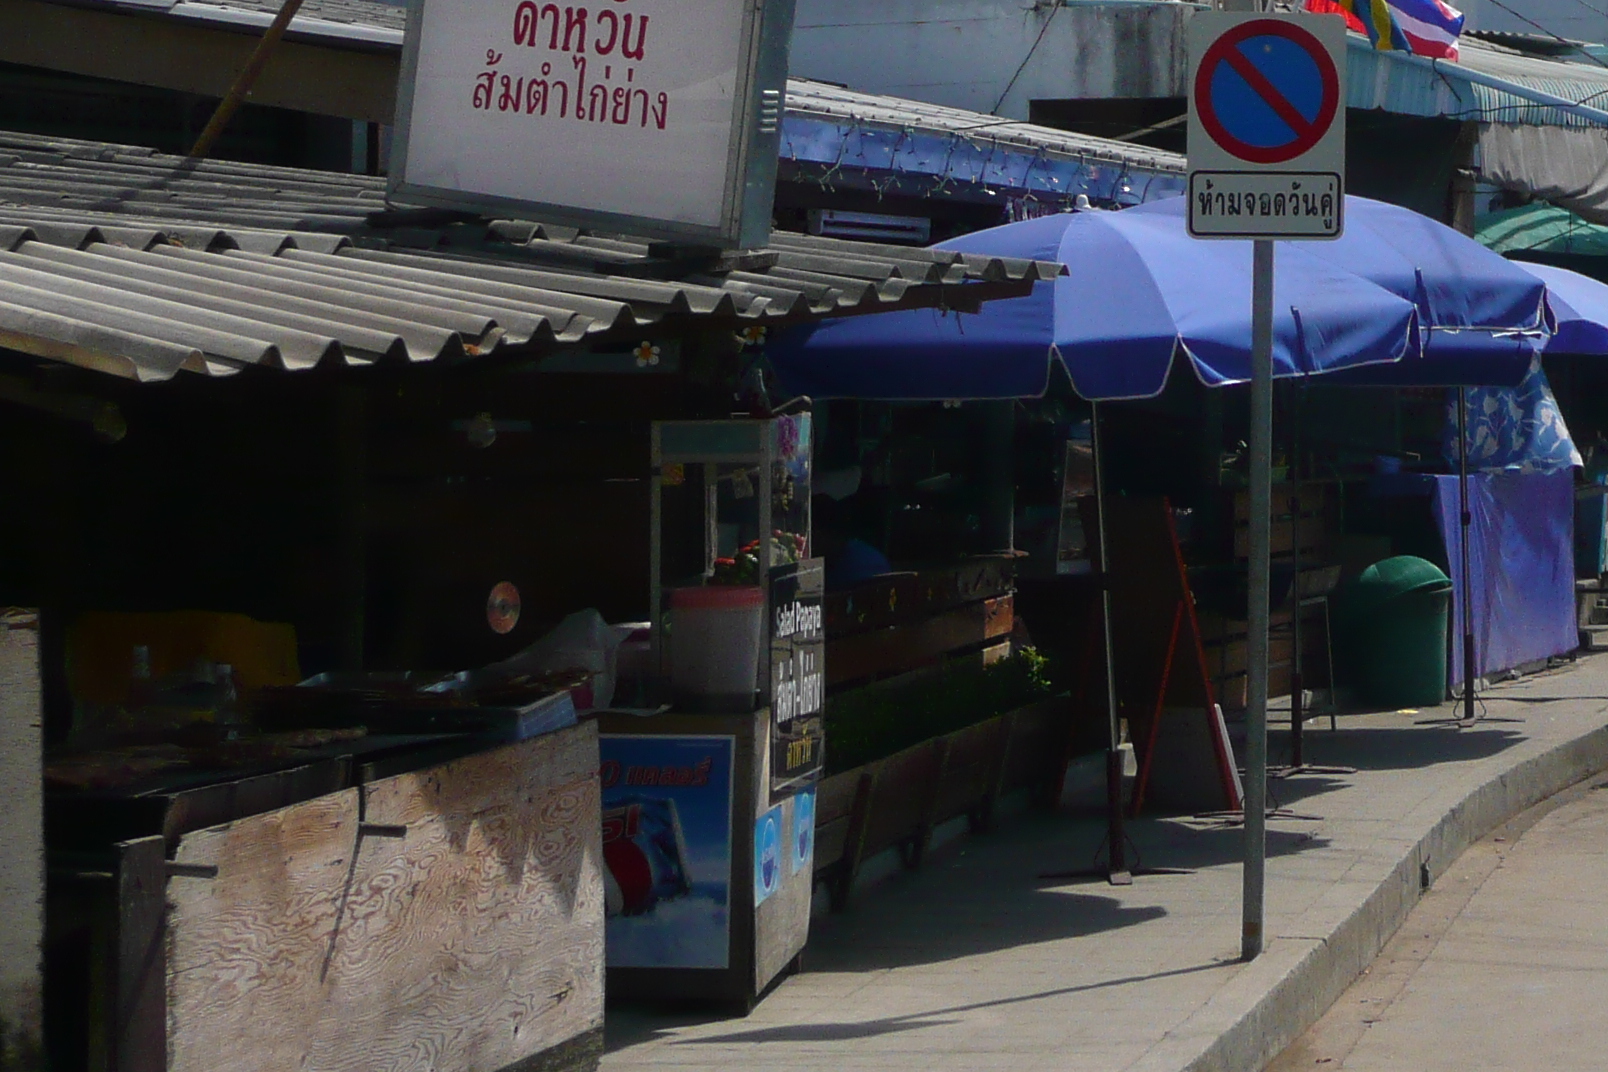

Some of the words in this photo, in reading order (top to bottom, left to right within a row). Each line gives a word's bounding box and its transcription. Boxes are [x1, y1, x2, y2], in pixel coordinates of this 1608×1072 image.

[473, 49, 668, 129] ส้มตำไก่ย่าง
[1198, 179, 1334, 229] ห้ามจอดวันคู่
[776, 601, 795, 638] Salad
[796, 601, 821, 638] Papaya
